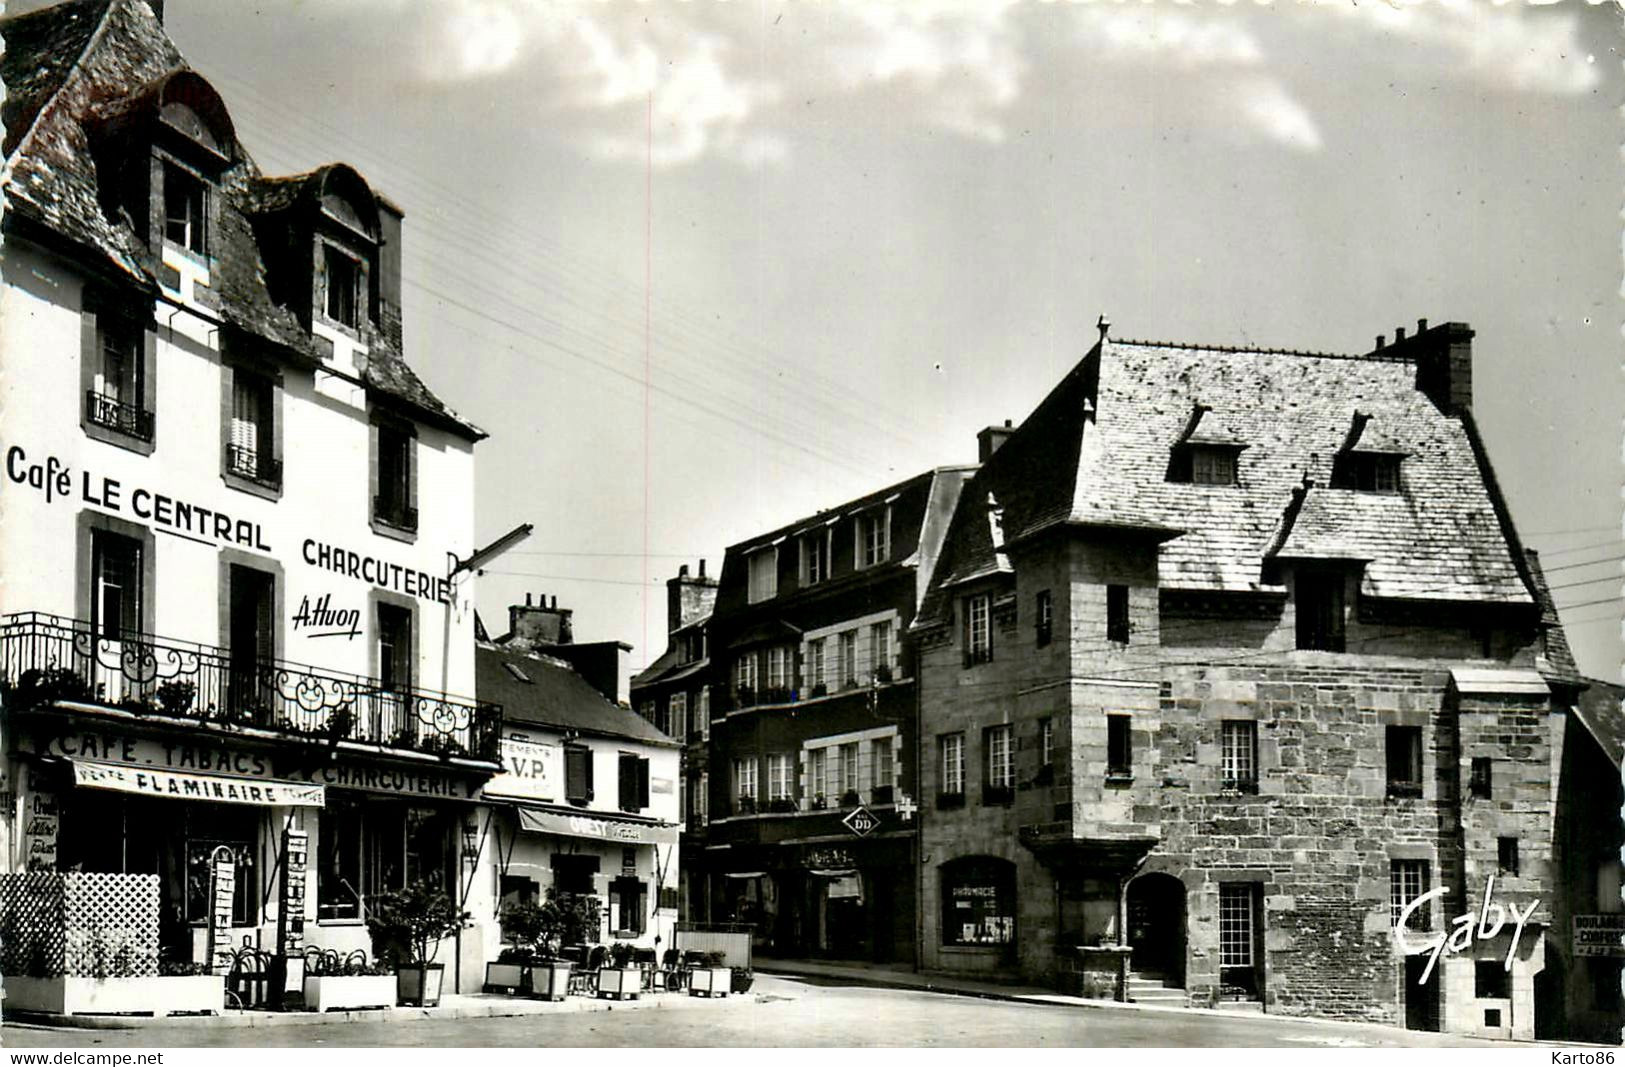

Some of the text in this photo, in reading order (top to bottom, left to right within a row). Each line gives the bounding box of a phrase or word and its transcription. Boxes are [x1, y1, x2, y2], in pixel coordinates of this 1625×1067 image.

[7, 446, 272, 552] Café LE CENTRAL
[302, 538, 450, 605] CHARCUTERIE
[162, 741, 265, 776] TABACS
[136, 773, 276, 803] FLAMINAIRE
[322, 765, 458, 797] CHARCUTERIE
[854, 819, 872, 830] DD
